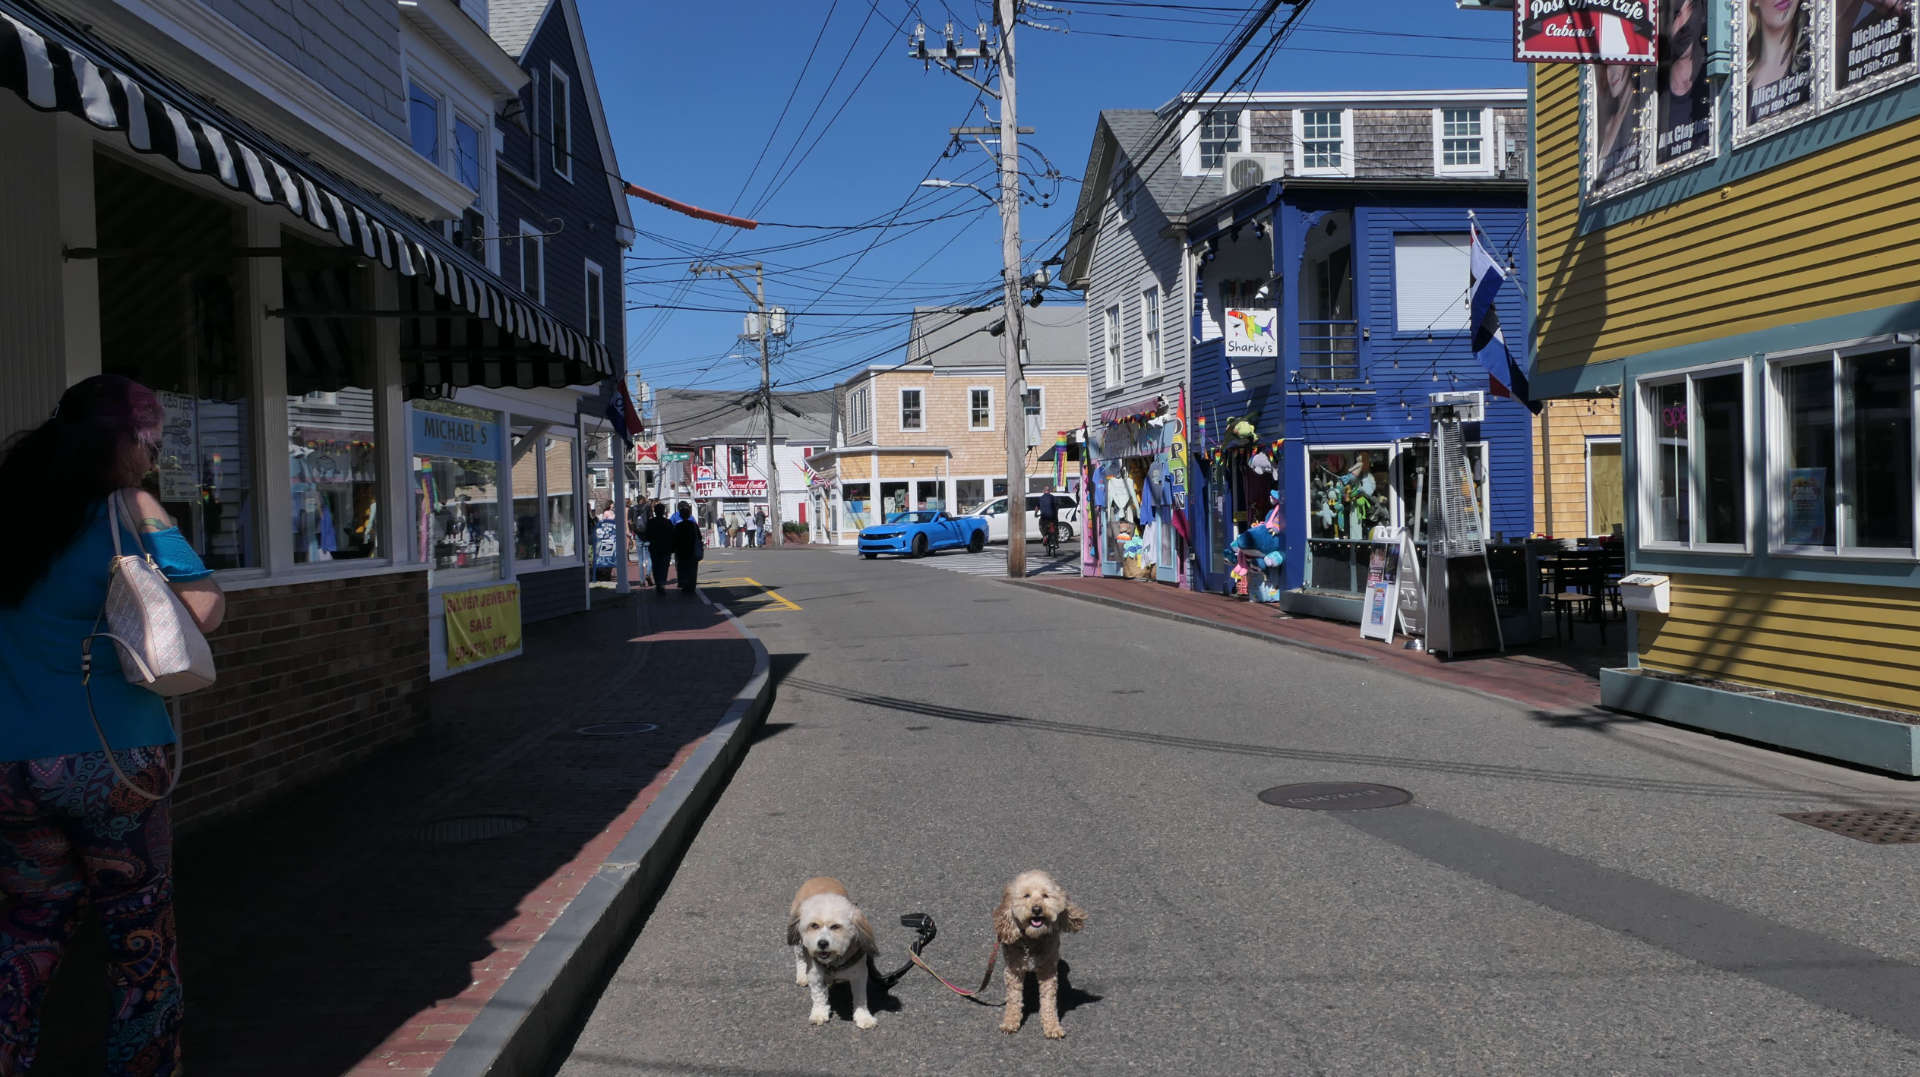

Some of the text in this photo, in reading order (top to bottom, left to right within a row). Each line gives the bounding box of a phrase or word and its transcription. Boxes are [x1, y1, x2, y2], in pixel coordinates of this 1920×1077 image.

[1545, 23, 1596, 38] Cabaret
[1851, 16, 1900, 49] Nicholas
[1848, 33, 1902, 68] Rodriguez
[1848, 67, 1863, 82] July
[1228, 340, 1273, 357] Sharky's
[423, 416, 488, 447] MICHAEL'S
[470, 616, 493, 632] SALE
